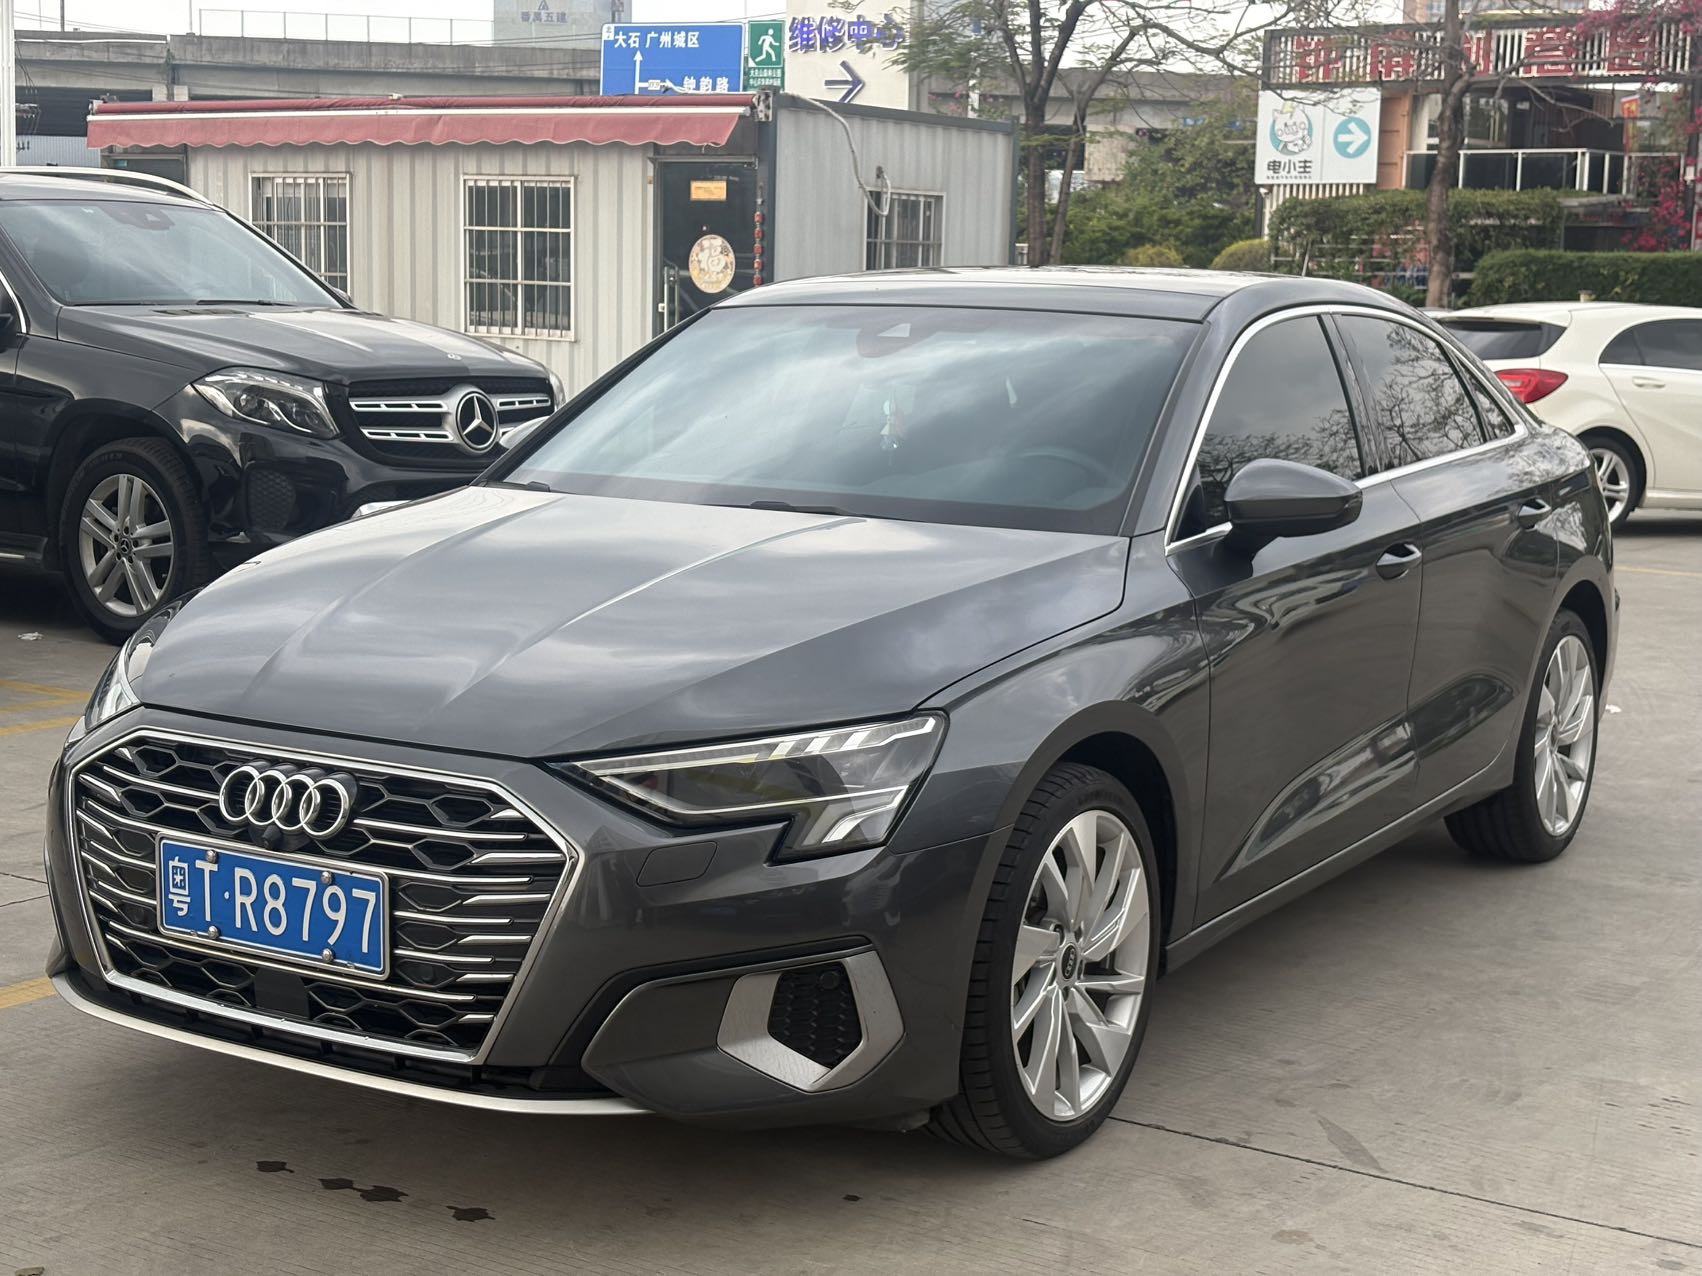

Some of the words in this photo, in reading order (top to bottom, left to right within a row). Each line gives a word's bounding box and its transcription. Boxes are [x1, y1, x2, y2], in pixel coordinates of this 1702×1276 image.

[614, 31, 641, 48] 大石
[645, 31, 700, 48] 广州城区
[789, 14, 905, 53] 维修中心
[1266, 159, 1313, 174] 电小主
